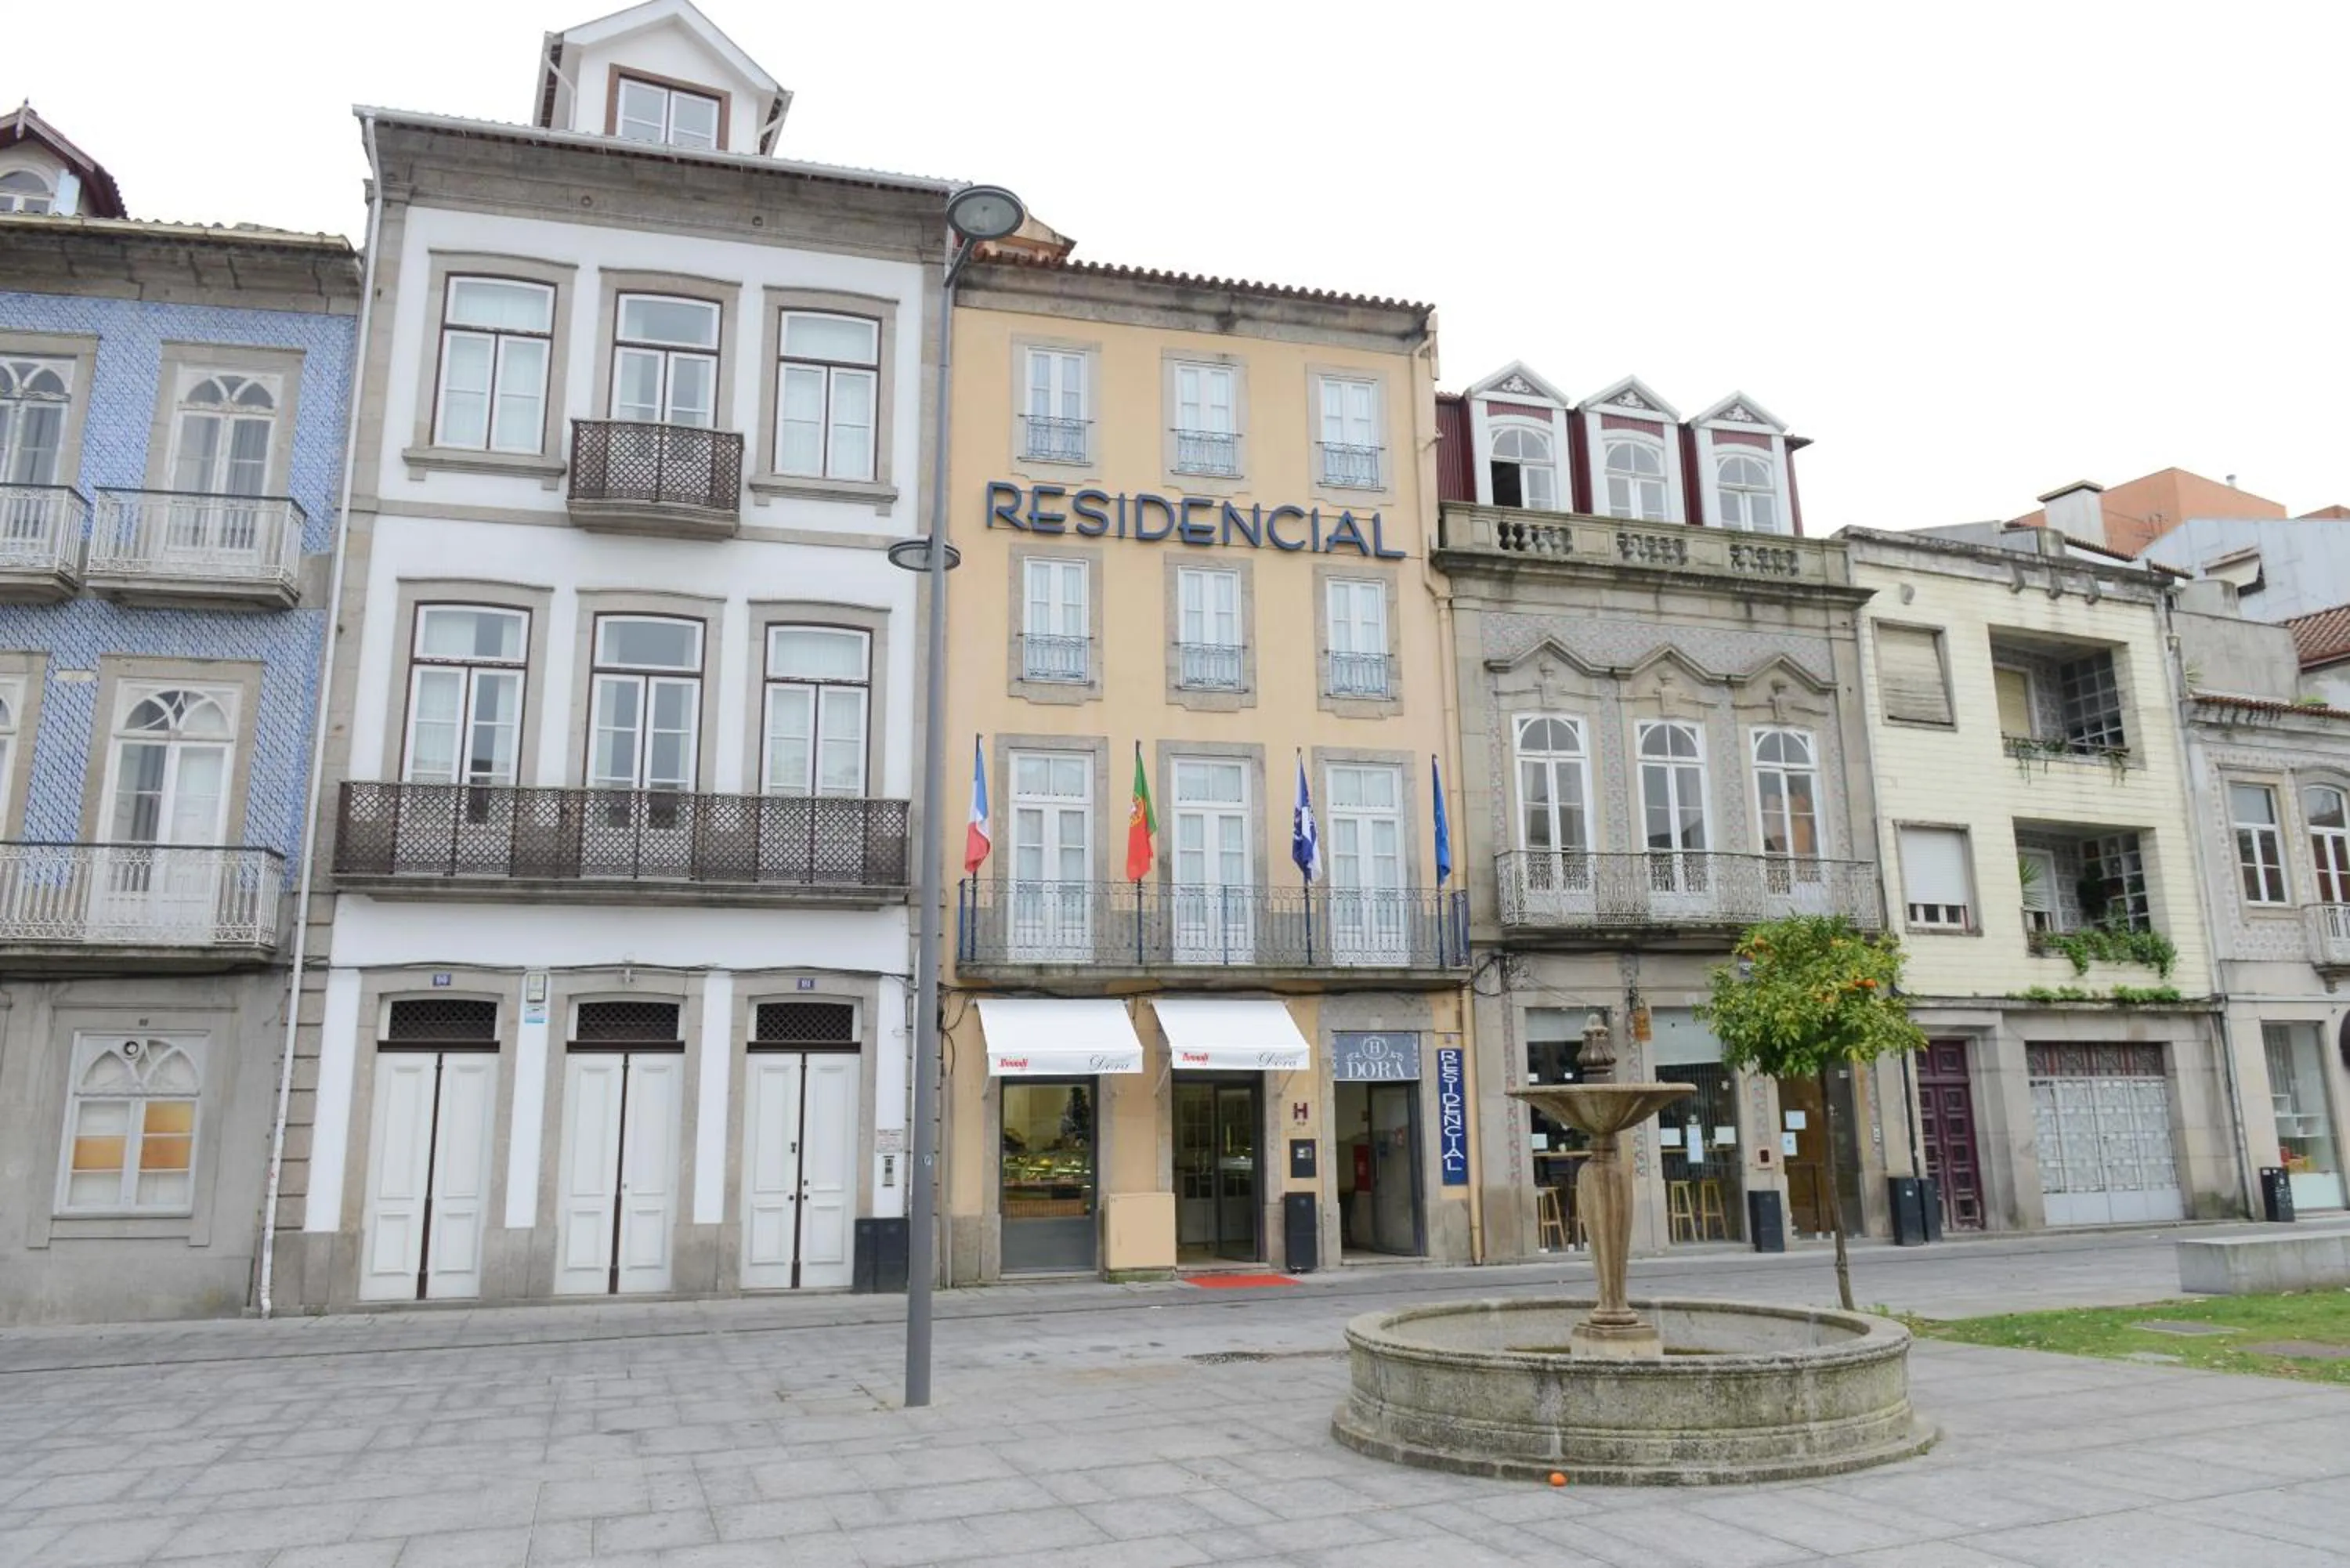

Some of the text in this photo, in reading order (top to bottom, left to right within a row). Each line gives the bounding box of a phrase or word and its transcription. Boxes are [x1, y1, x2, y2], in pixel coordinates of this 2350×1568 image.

[985, 481, 1406, 559] RESIDENCIAL
[1369, 1041, 1380, 1053] H
[1347, 1061, 1405, 1078] DORA
[1293, 1102, 1308, 1120] H
[1441, 1050, 1465, 1171] RESIDENCIAL
